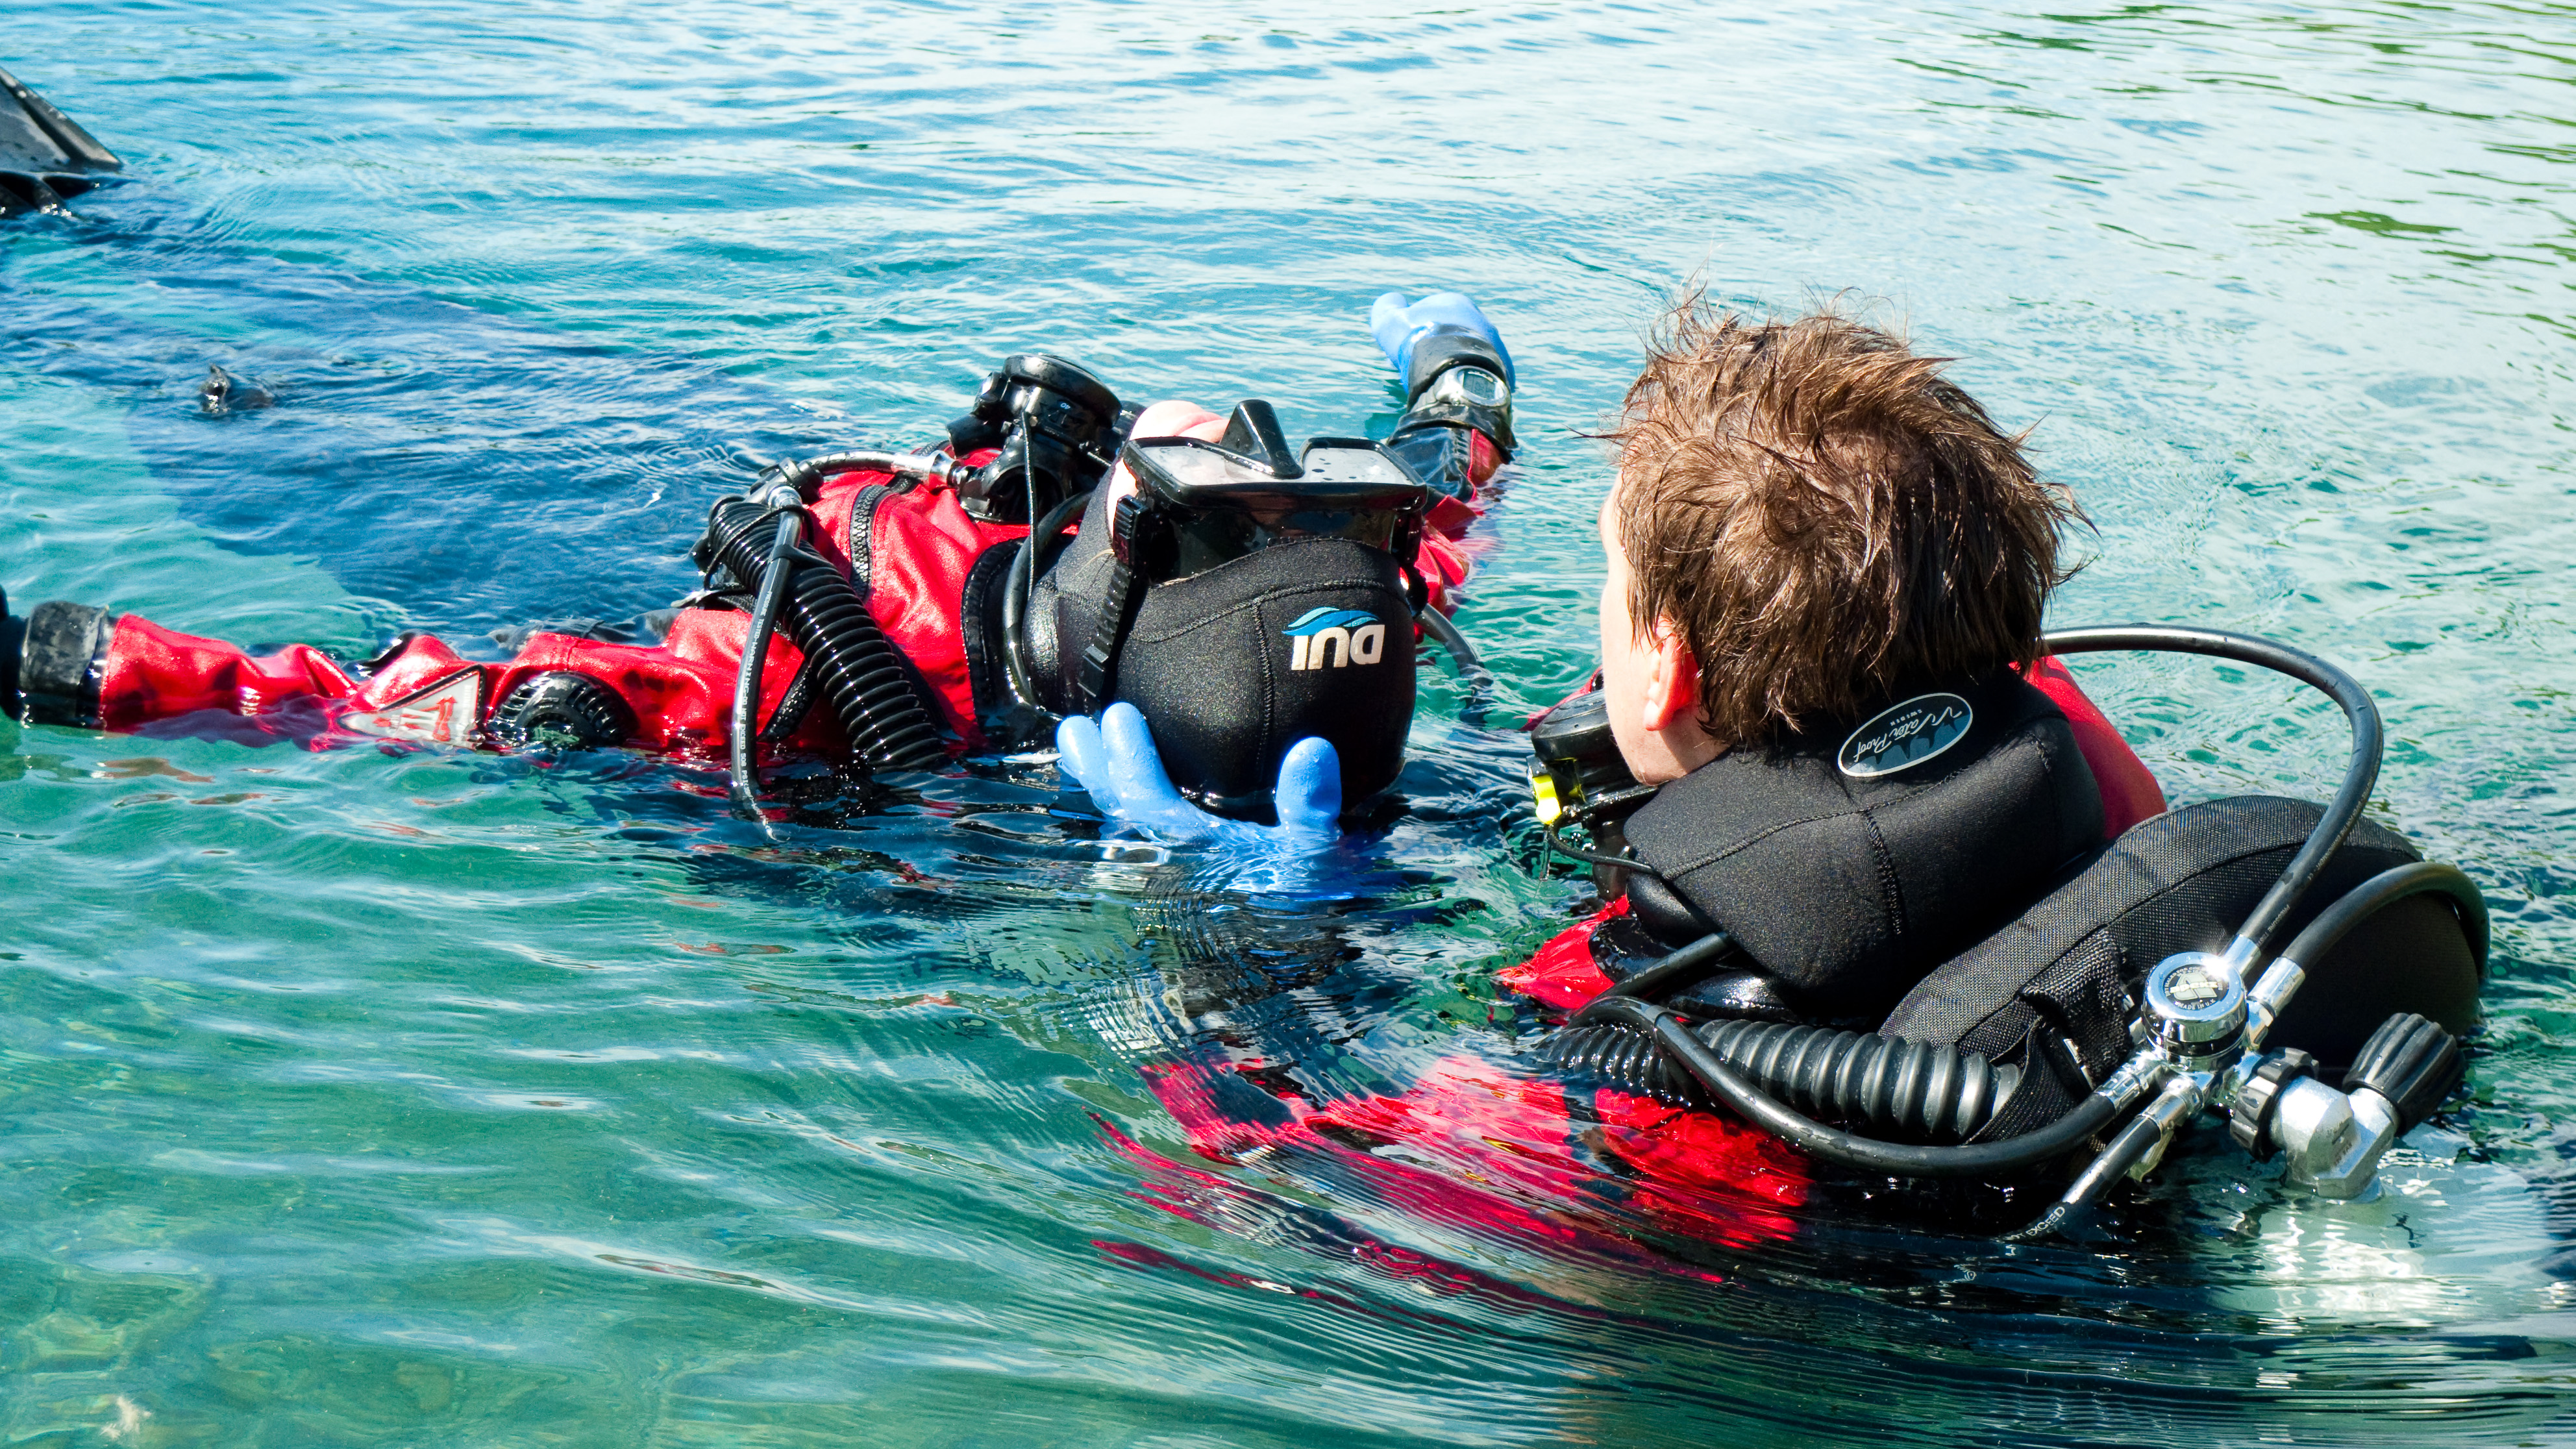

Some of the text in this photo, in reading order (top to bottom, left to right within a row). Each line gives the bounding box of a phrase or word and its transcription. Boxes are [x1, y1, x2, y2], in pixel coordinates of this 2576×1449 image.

[1291, 625, 1385, 671] DUI
[1853, 706, 1963, 763] Water Proof
[1890, 709, 1922, 726] SWEDEN
[2026, 1206, 2065, 1235] EXCEED
